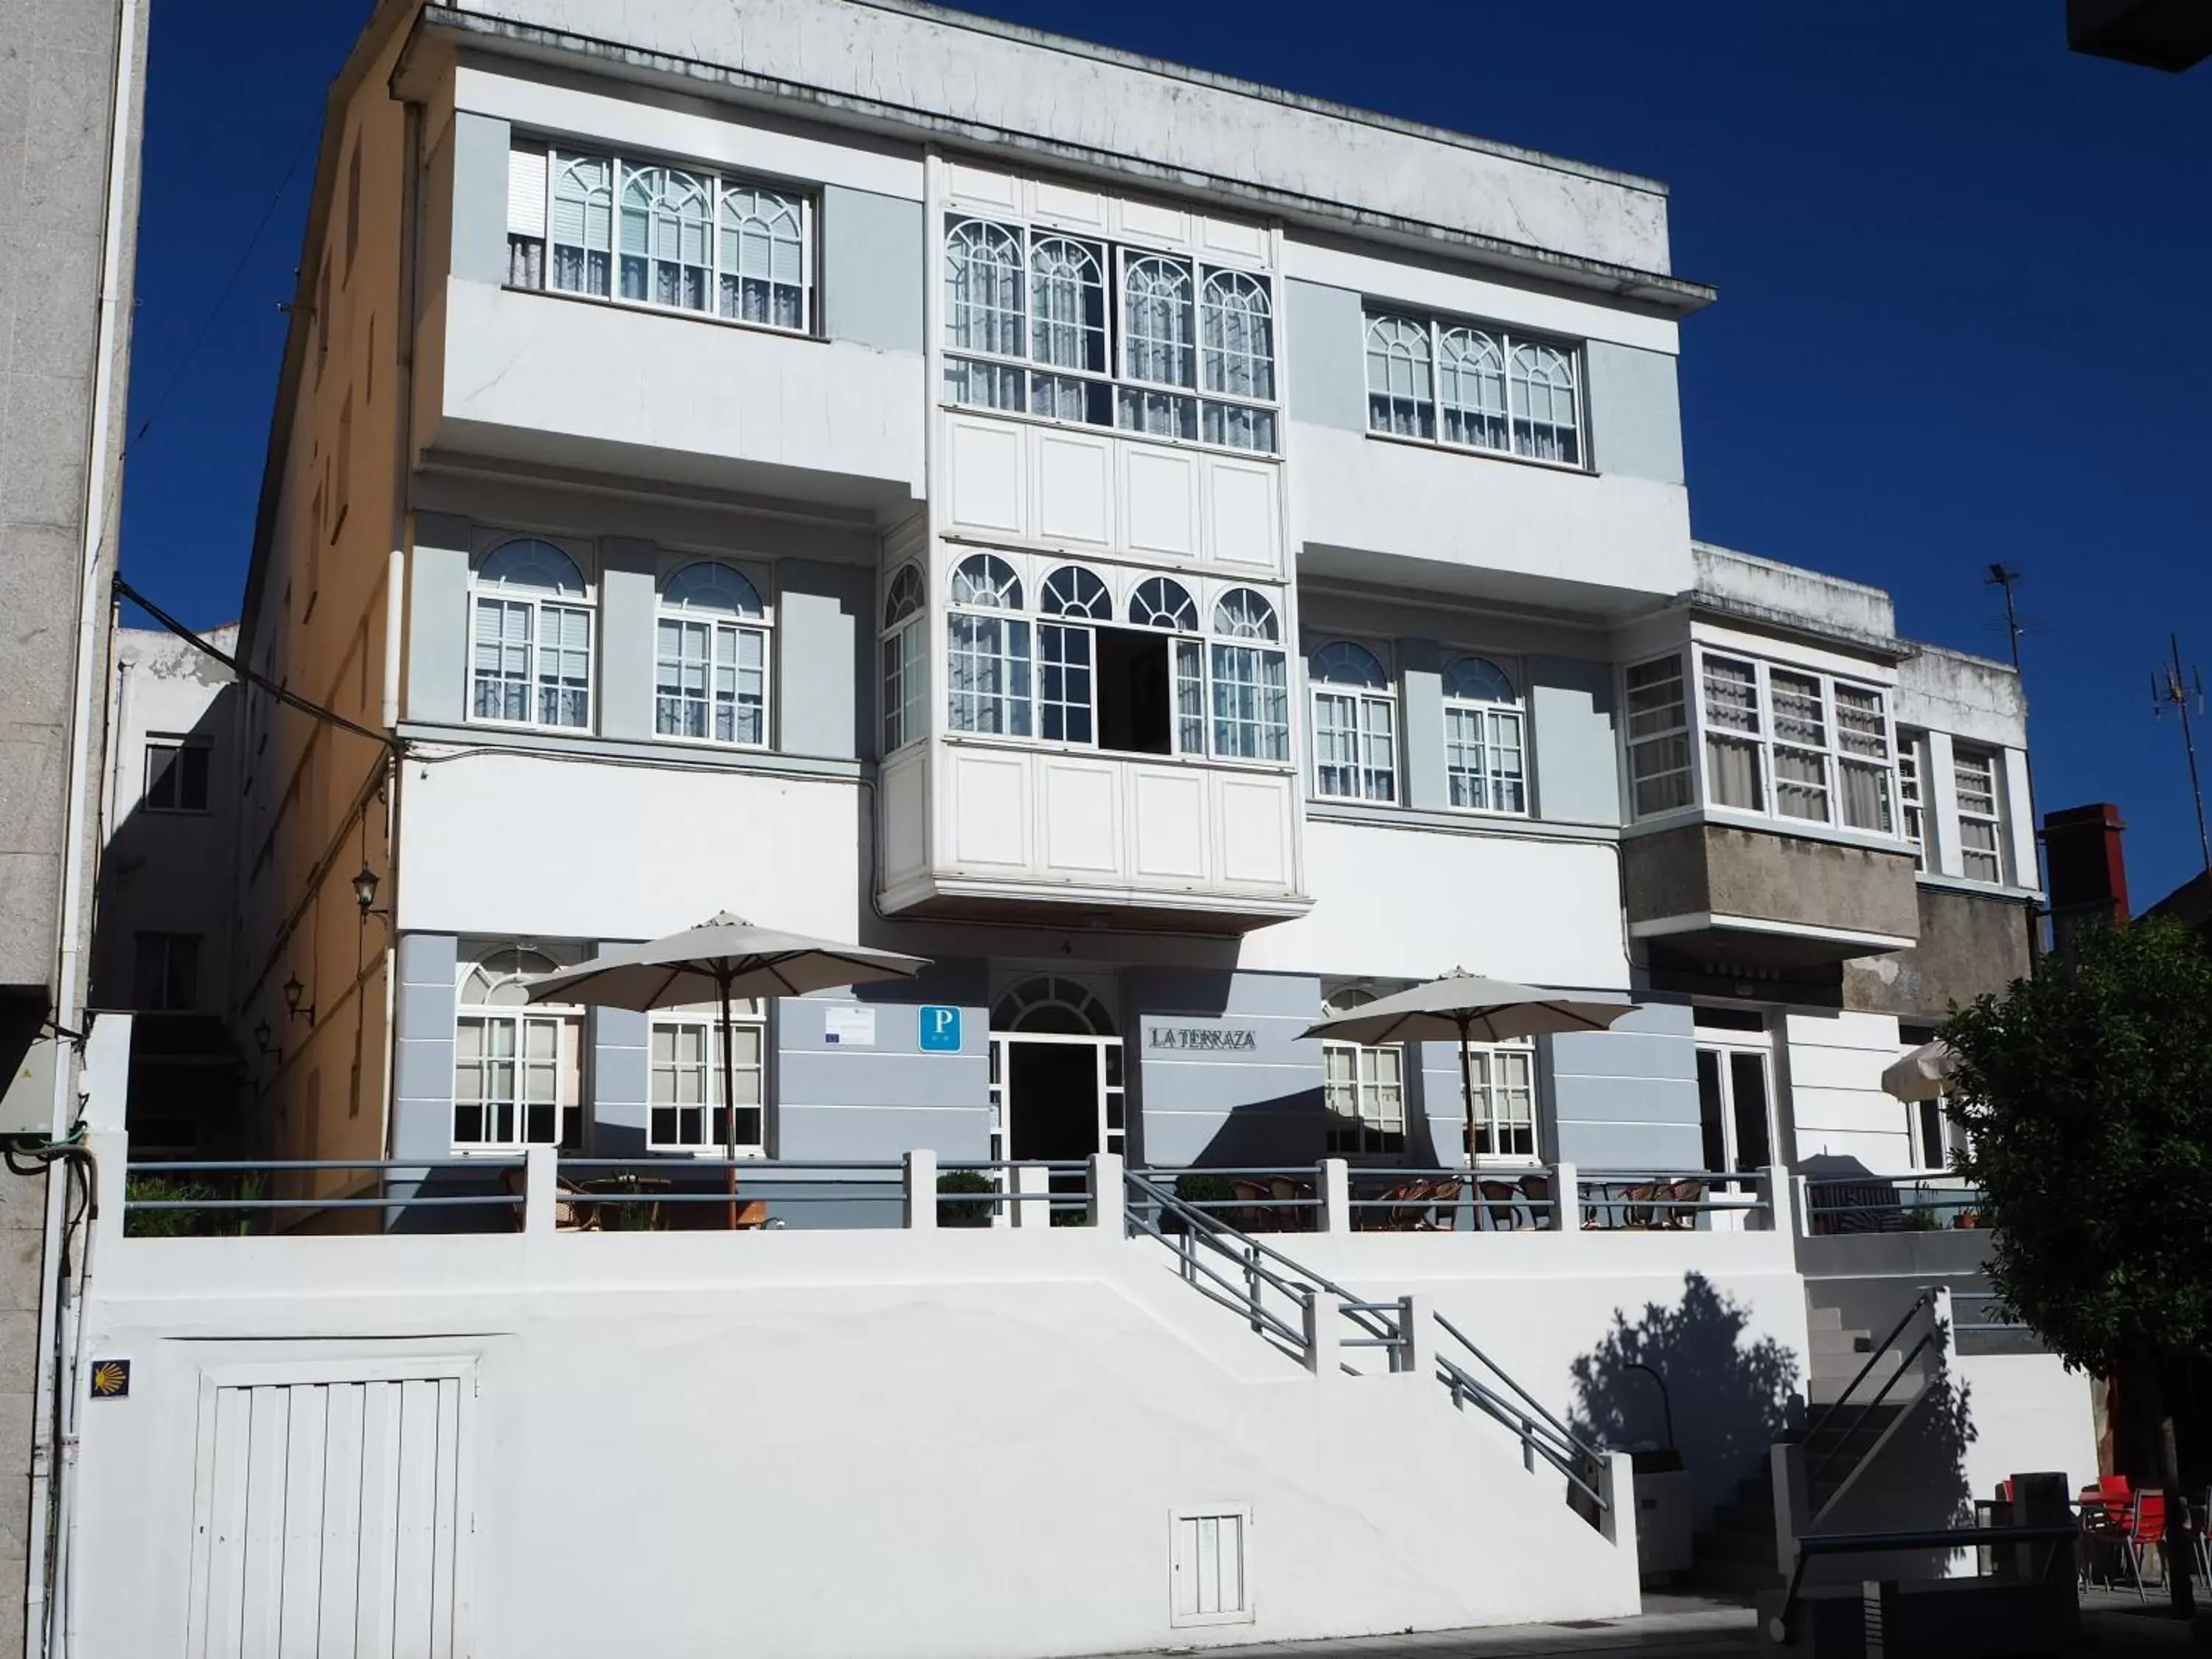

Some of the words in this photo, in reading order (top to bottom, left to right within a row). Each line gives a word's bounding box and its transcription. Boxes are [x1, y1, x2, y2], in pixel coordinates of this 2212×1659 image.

[932, 1009, 953, 1033] P
[1150, 1028, 1175, 1048] LA
[1179, 1029, 1256, 1050] TERRAZA
